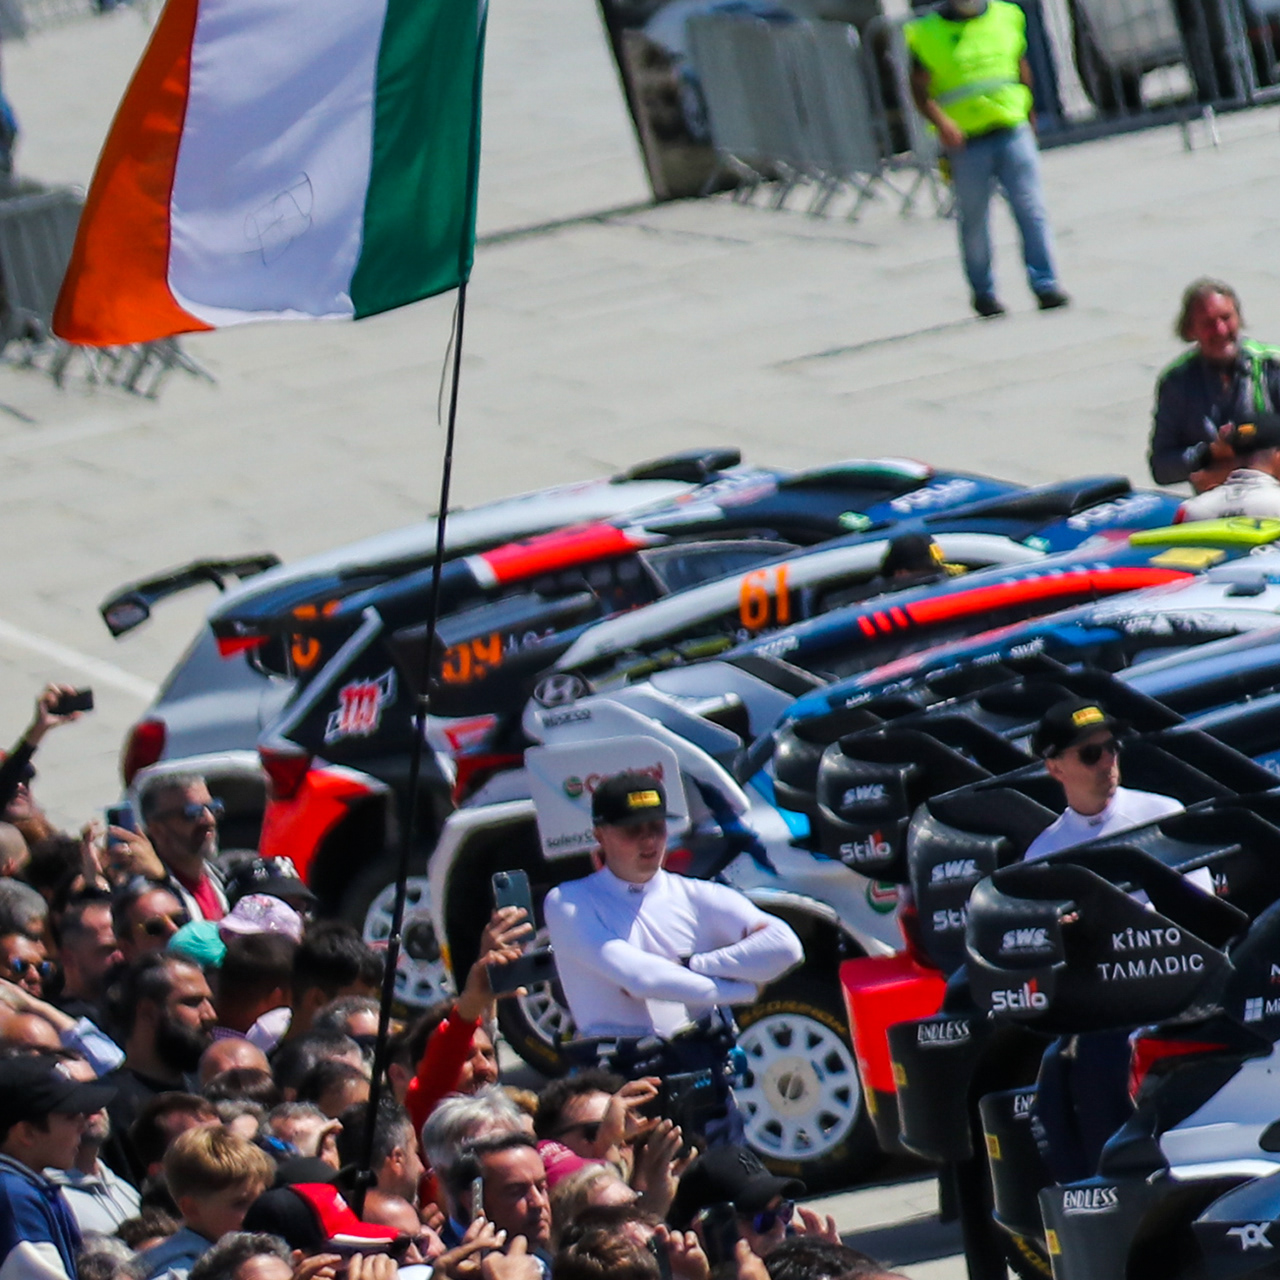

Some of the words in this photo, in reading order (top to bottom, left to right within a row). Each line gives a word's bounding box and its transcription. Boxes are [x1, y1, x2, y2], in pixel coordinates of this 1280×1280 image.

[739, 564, 791, 630] 61
[933, 909, 967, 931] Sti
[1112, 927, 1181, 950] KINTO
[1098, 953, 1204, 981] TAMADIC
[991, 982, 1048, 1011] Stilo
[917, 1020, 971, 1043] ENDLESS
[1063, 1186, 1119, 1209] ENDLESS
